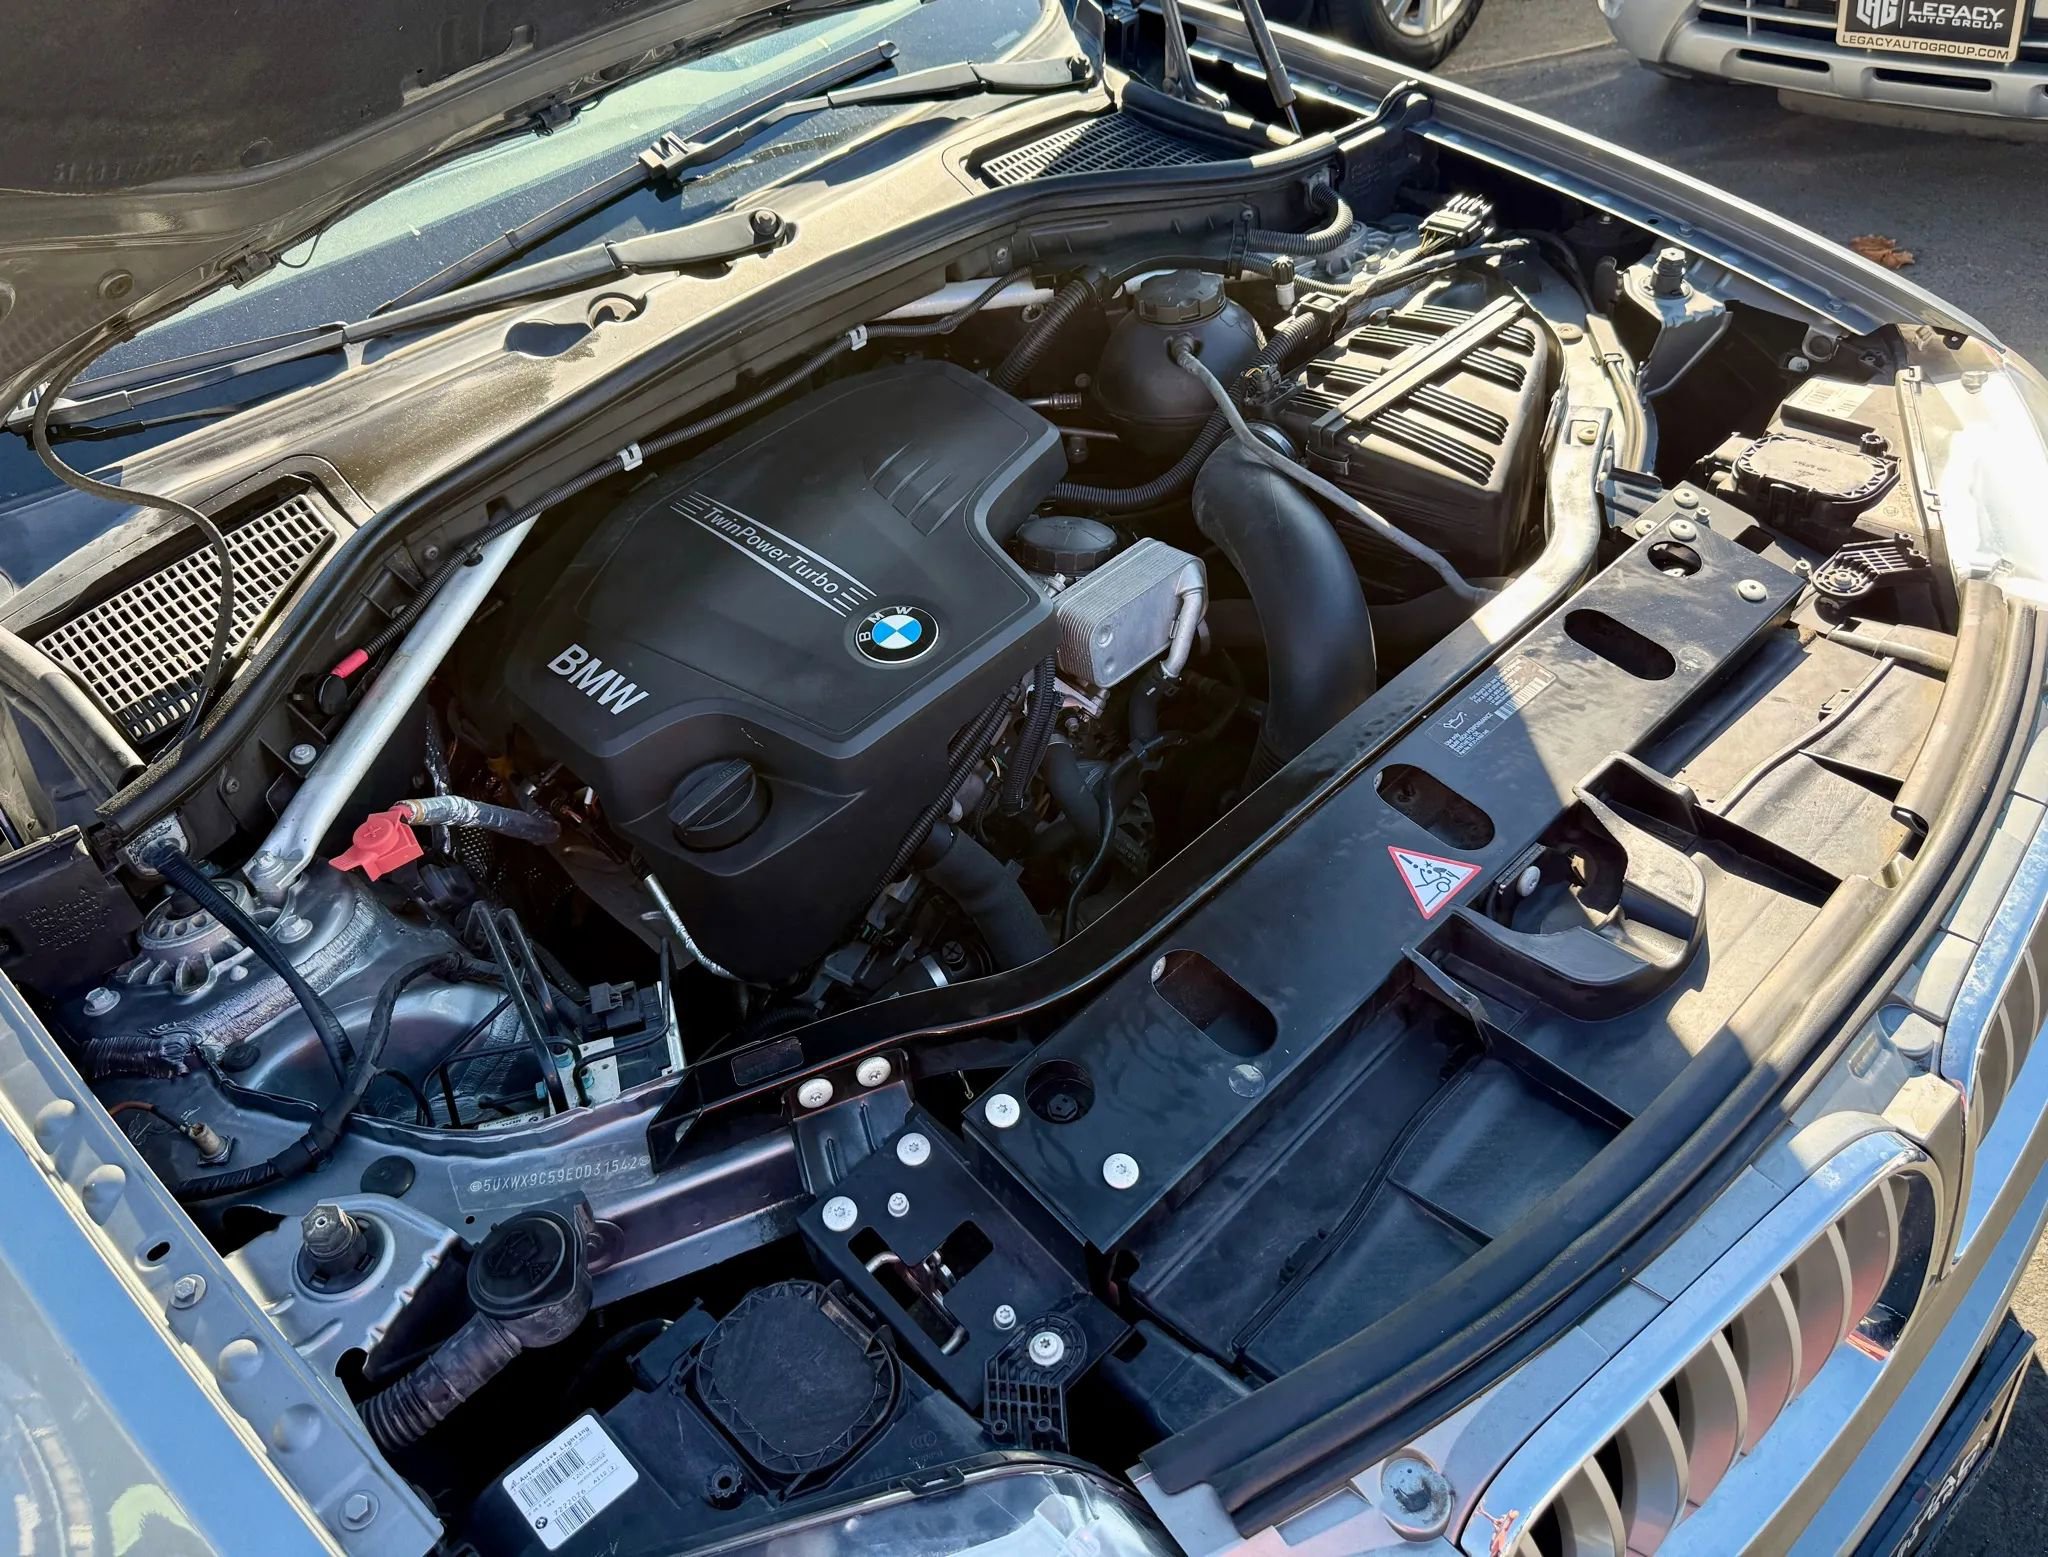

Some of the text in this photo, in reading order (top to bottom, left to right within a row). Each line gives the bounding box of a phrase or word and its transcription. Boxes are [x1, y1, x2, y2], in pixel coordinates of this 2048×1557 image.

[1907, 14, 2004, 30] AUTO GROUP
[1908, 0, 2006, 22] LEGACY
[1842, 34, 2010, 61] LEGACYAUTOGROUP.COM
[703, 507, 841, 595] TwinPower Turbo
[858, 605, 914, 644] BMW
[546, 643, 650, 716] BMW
[519, 1450, 557, 1483] Automotive
[558, 1425, 590, 1451] Lighting
